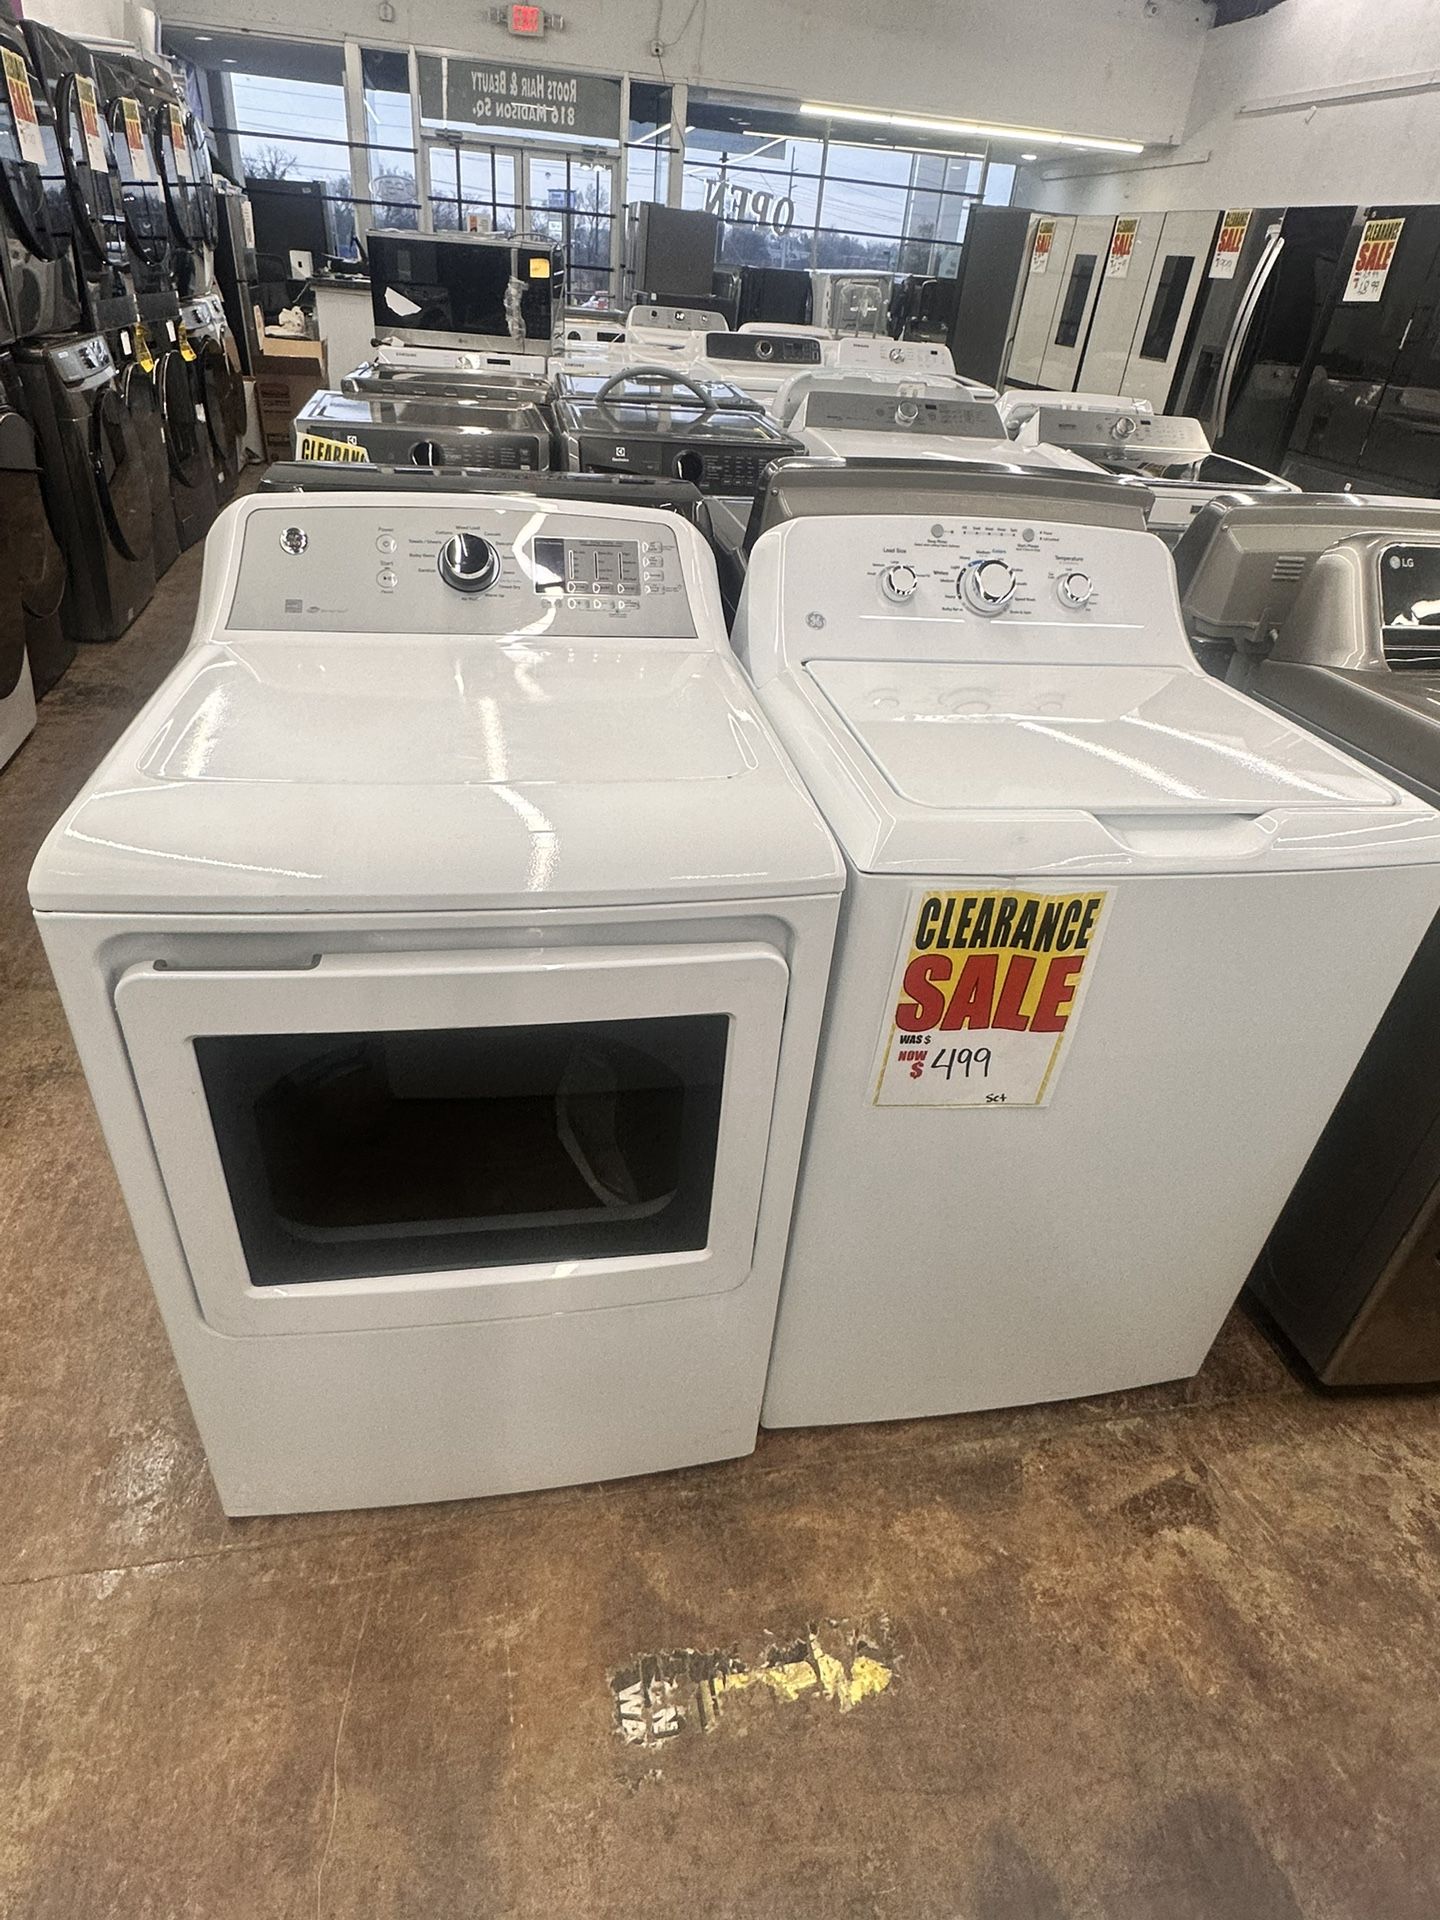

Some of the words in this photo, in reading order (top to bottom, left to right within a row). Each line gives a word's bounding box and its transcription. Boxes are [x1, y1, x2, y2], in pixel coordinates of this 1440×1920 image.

[1217, 228, 1246, 253] SALE
[1355, 242, 1396, 271] SALE
[1401, 558, 1415, 568] LG
[915, 896, 1101, 952] CLEARANCE
[895, 953, 1085, 1032] SALE
[900, 1034, 923, 1045] WAS
[923, 1034, 932, 1045] $
[898, 1050, 928, 1061] NOW
[910, 1061, 924, 1080] $
[931, 1047, 992, 1080] 499
